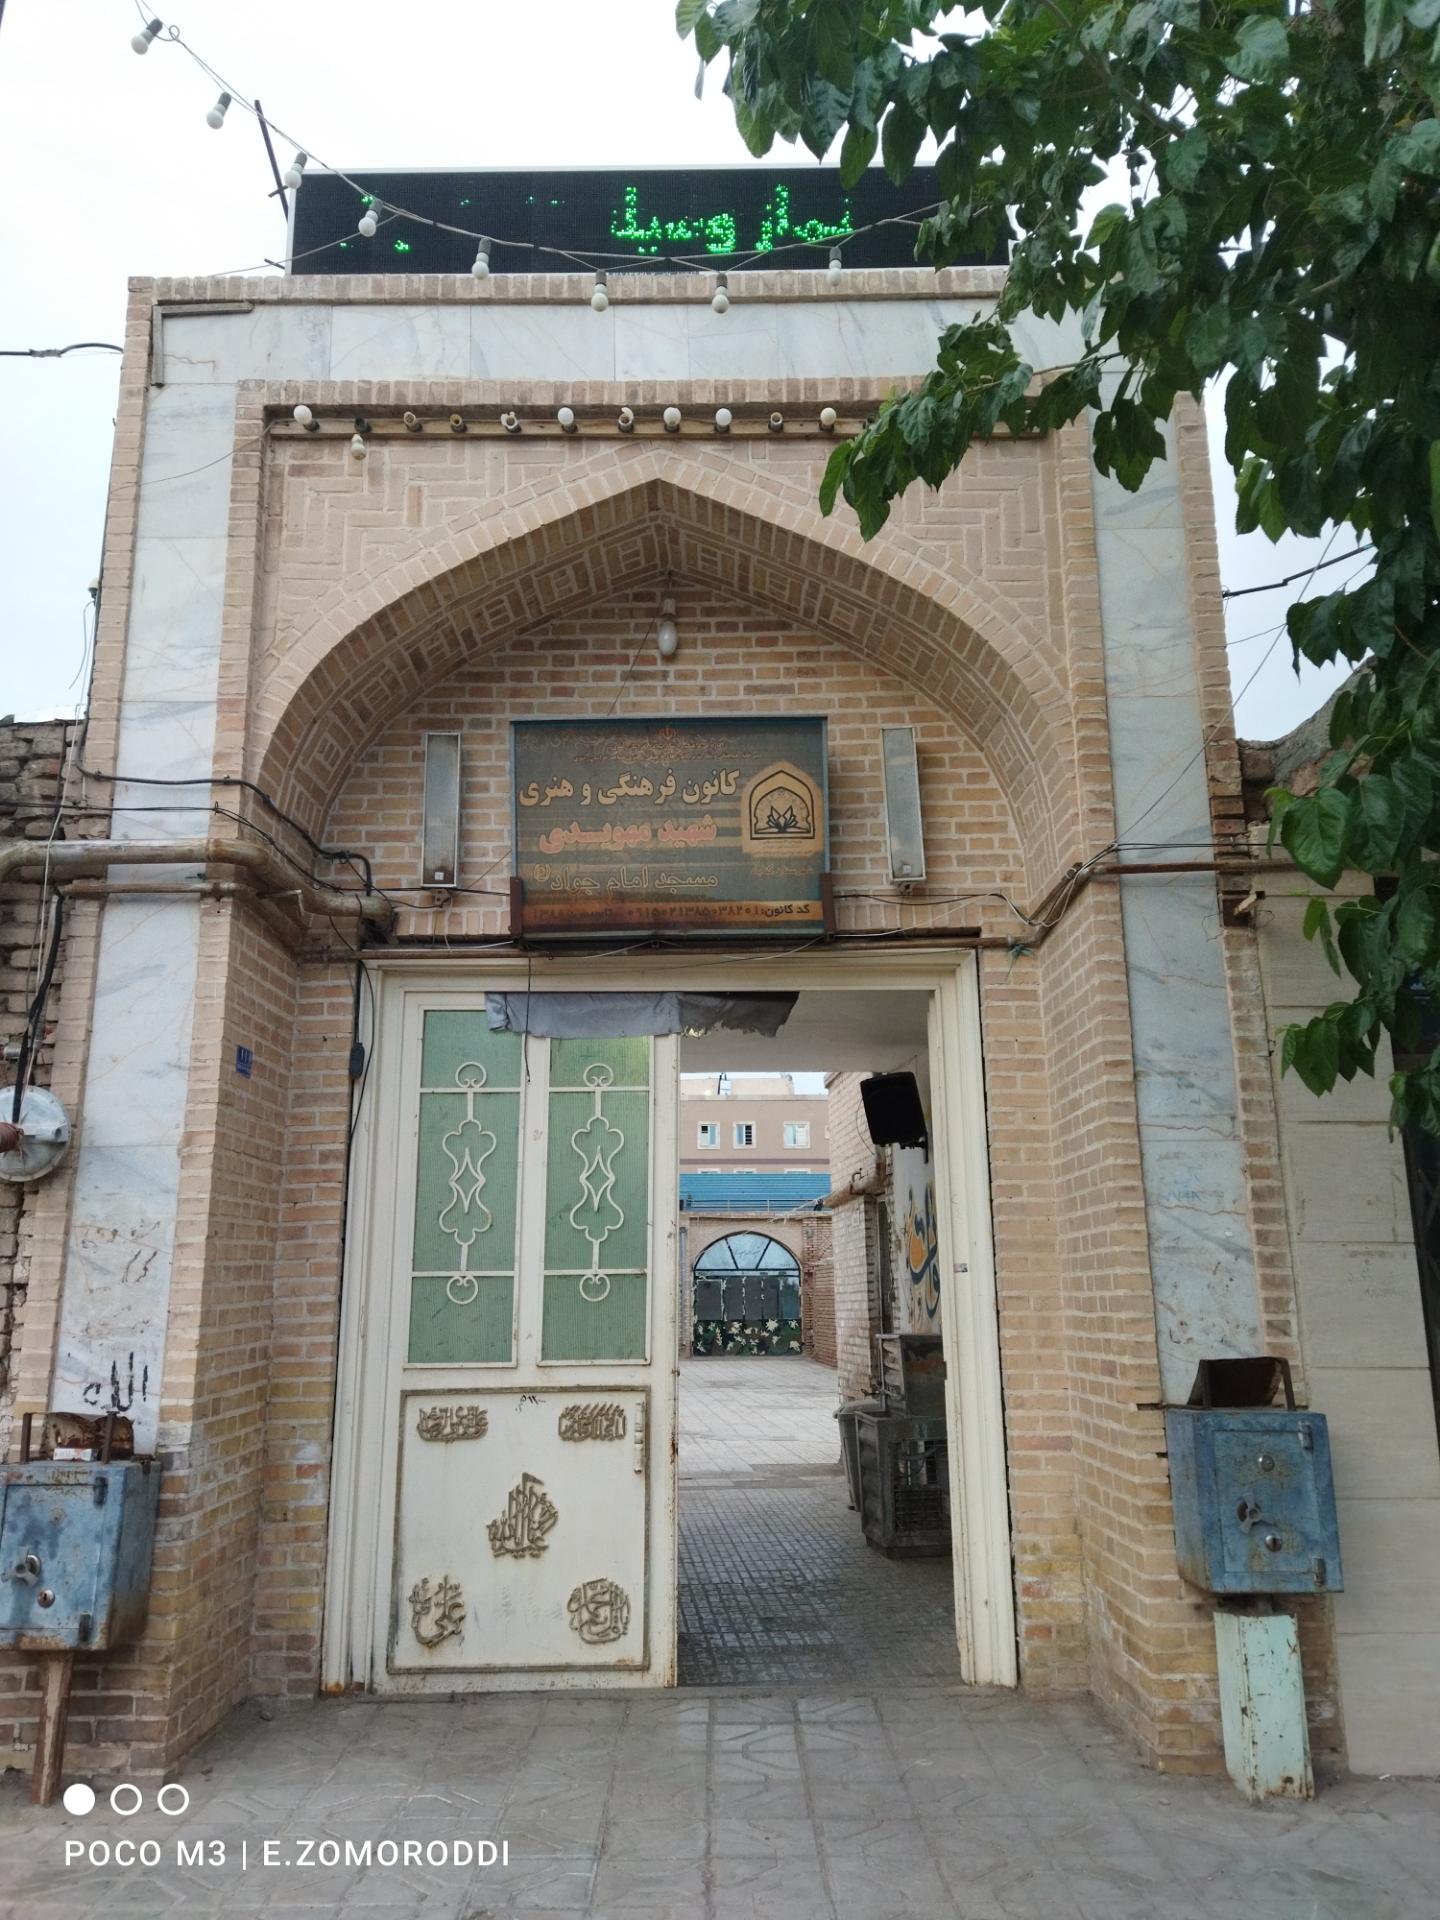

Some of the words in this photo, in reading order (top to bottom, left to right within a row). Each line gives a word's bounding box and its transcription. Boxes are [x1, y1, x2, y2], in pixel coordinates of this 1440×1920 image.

[519, 776, 575, 806] هنری
[580, 781, 592, 805] و
[597, 768, 677, 805] فرهنگی
[682, 768, 740, 804] کانون
[657, 814, 718, 849] شهید
[550, 865, 600, 896] جواد
[606, 865, 649, 894] امام
[655, 872, 719, 896] مسجد
[796, 903, 811, 914] کد
